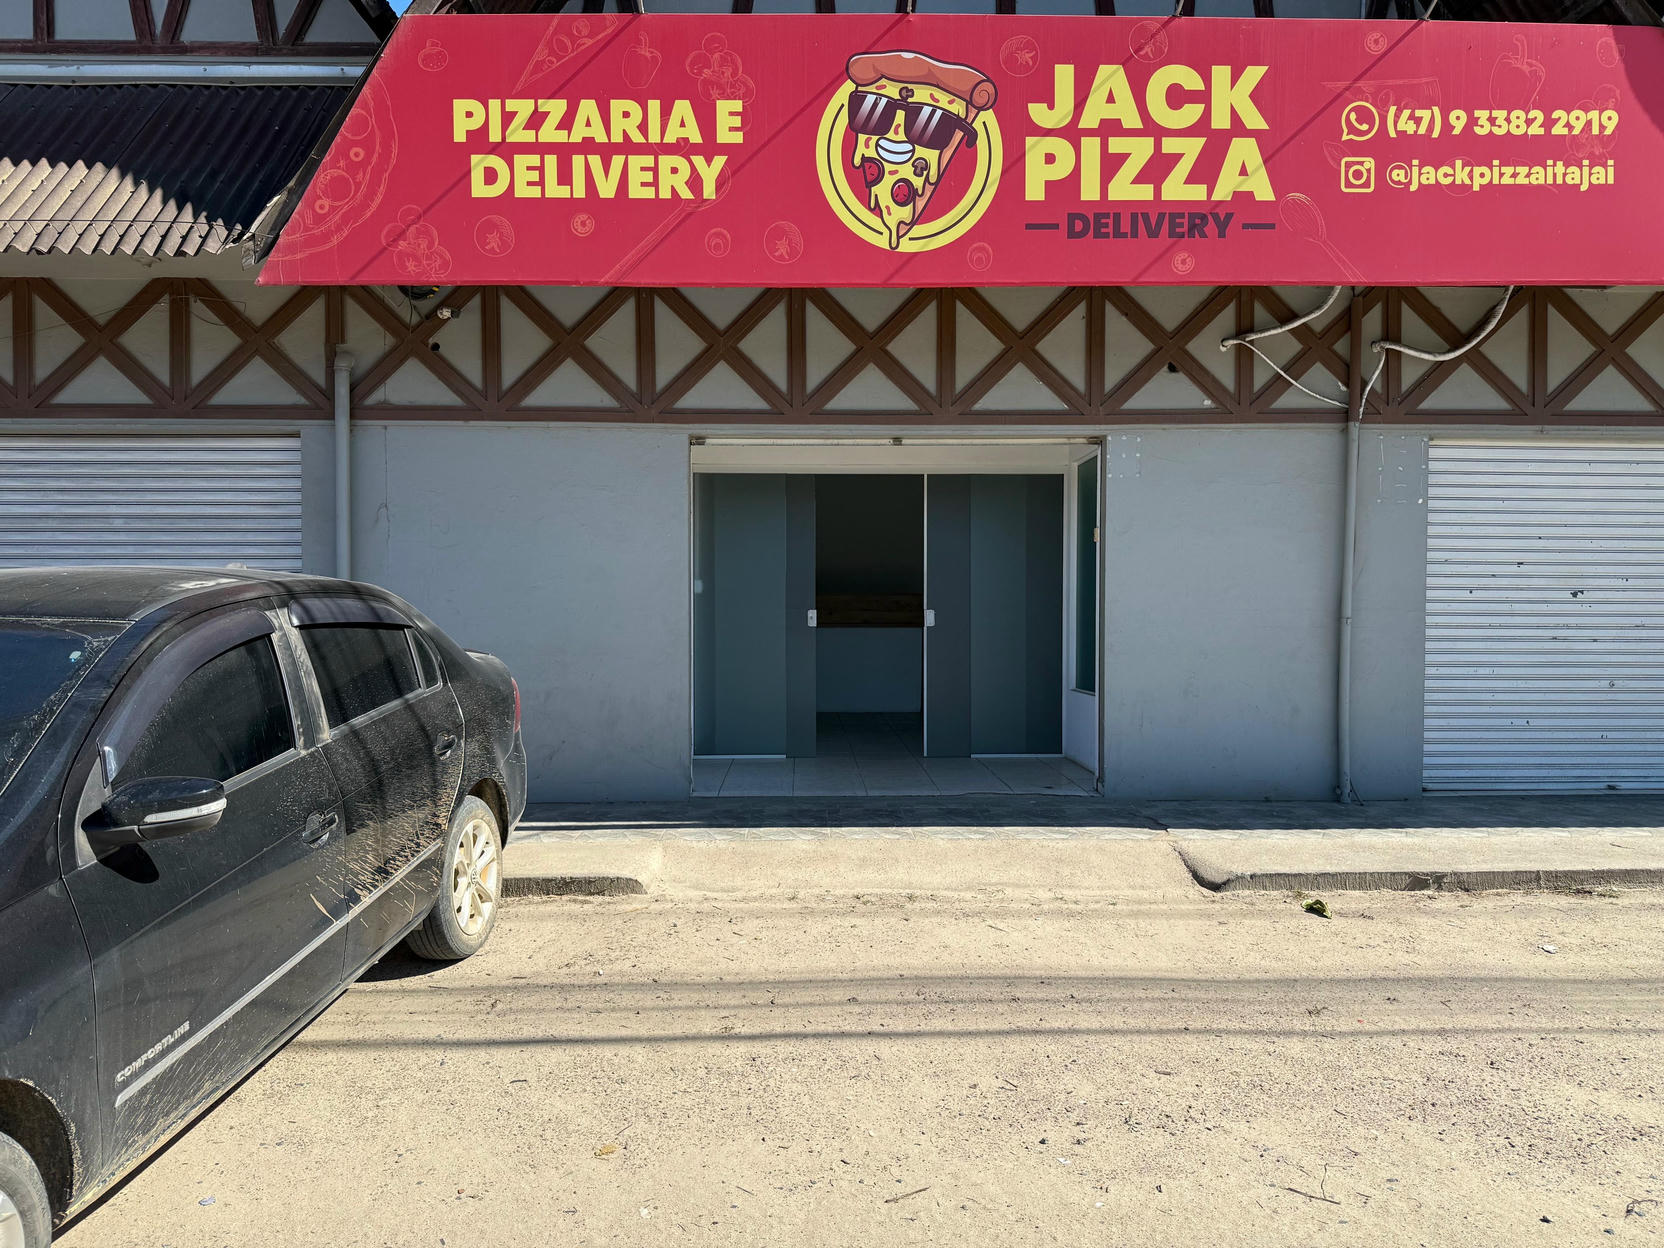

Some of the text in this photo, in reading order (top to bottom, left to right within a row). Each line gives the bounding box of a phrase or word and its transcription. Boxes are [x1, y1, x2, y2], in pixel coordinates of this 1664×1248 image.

[1028, 64, 1269, 130] JACK
[453, 99, 743, 144] PIZZARIA E
[1387, 106, 1619, 138] (47) 9 3382 2919
[471, 155, 728, 200] DELIVERY
[1025, 137, 1276, 201] PIZZA
[1387, 160, 1615, 191] @jackpizzaitajai
[1067, 212, 1235, 239] DELIVERY
[115, 1020, 190, 1084] COMFORTLINE
